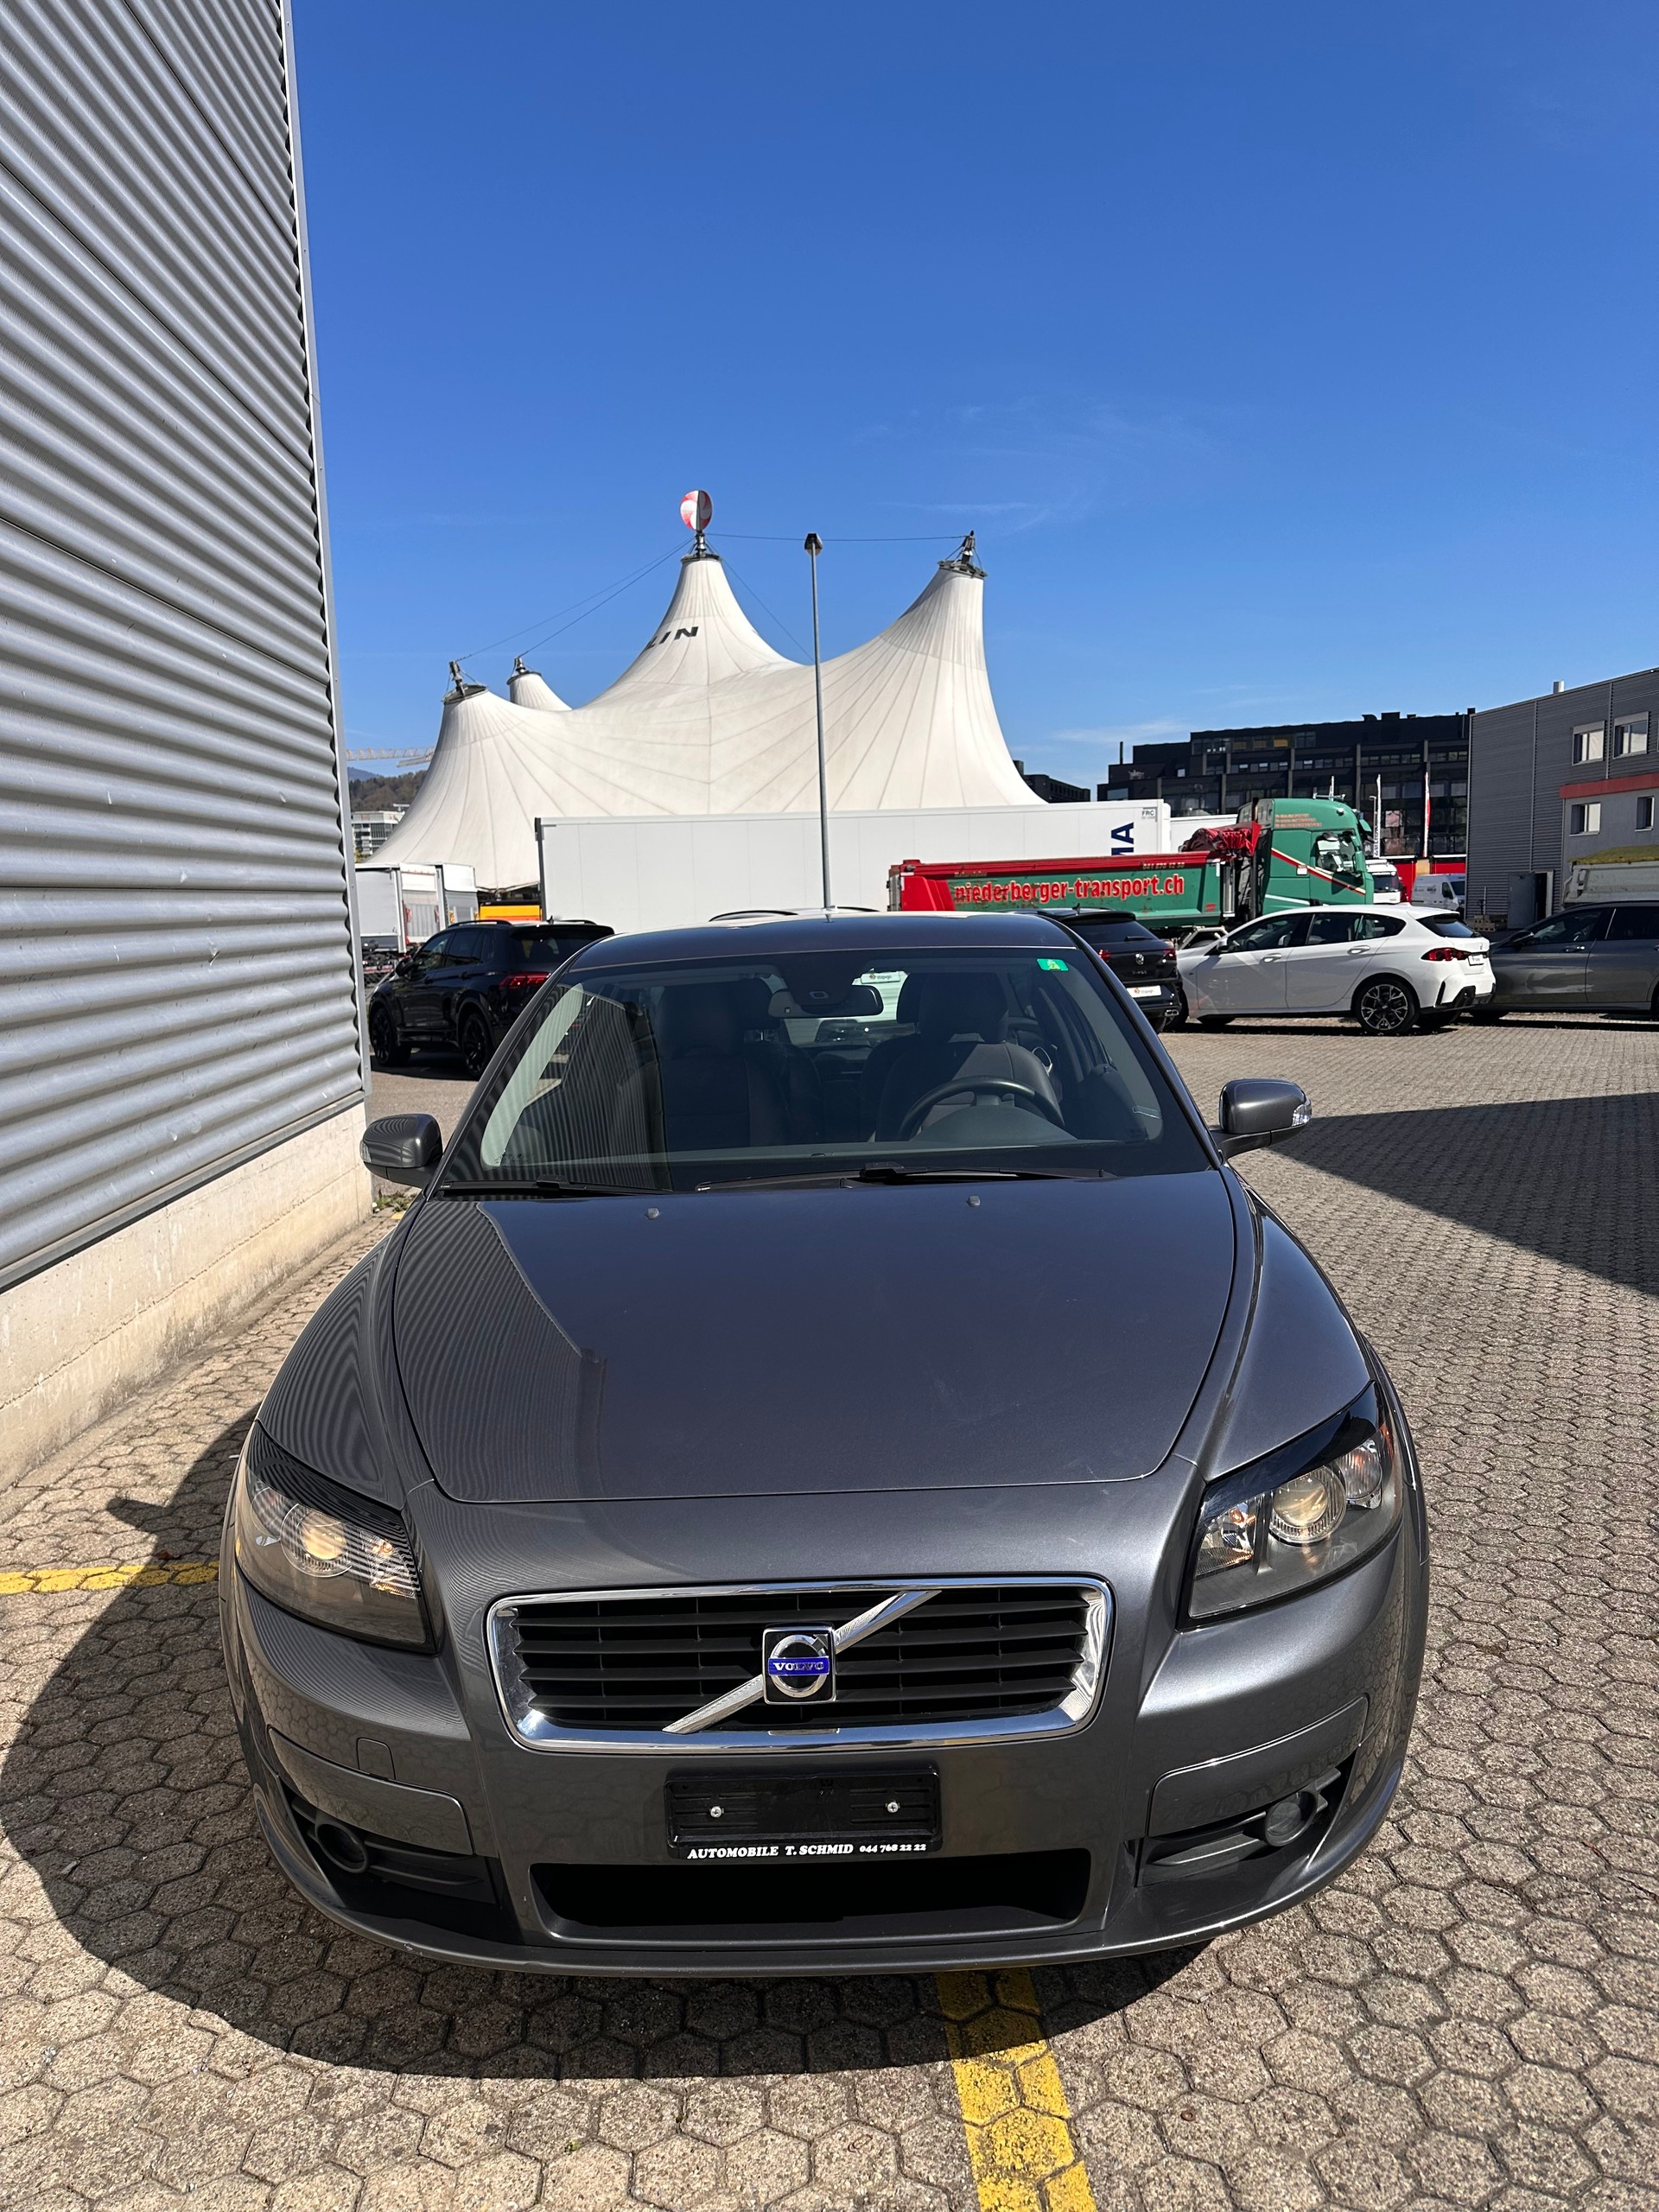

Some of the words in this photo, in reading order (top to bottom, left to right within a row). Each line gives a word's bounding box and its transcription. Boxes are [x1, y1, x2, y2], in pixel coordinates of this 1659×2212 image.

[953, 873, 1185, 904] niederberger-transport.ch
[772, 1662, 825, 1671] VOLVO
[687, 1847, 779, 1859] AUTOMOBILE
[859, 1845, 878, 1853] 044
[880, 1844, 899, 1853] 768
